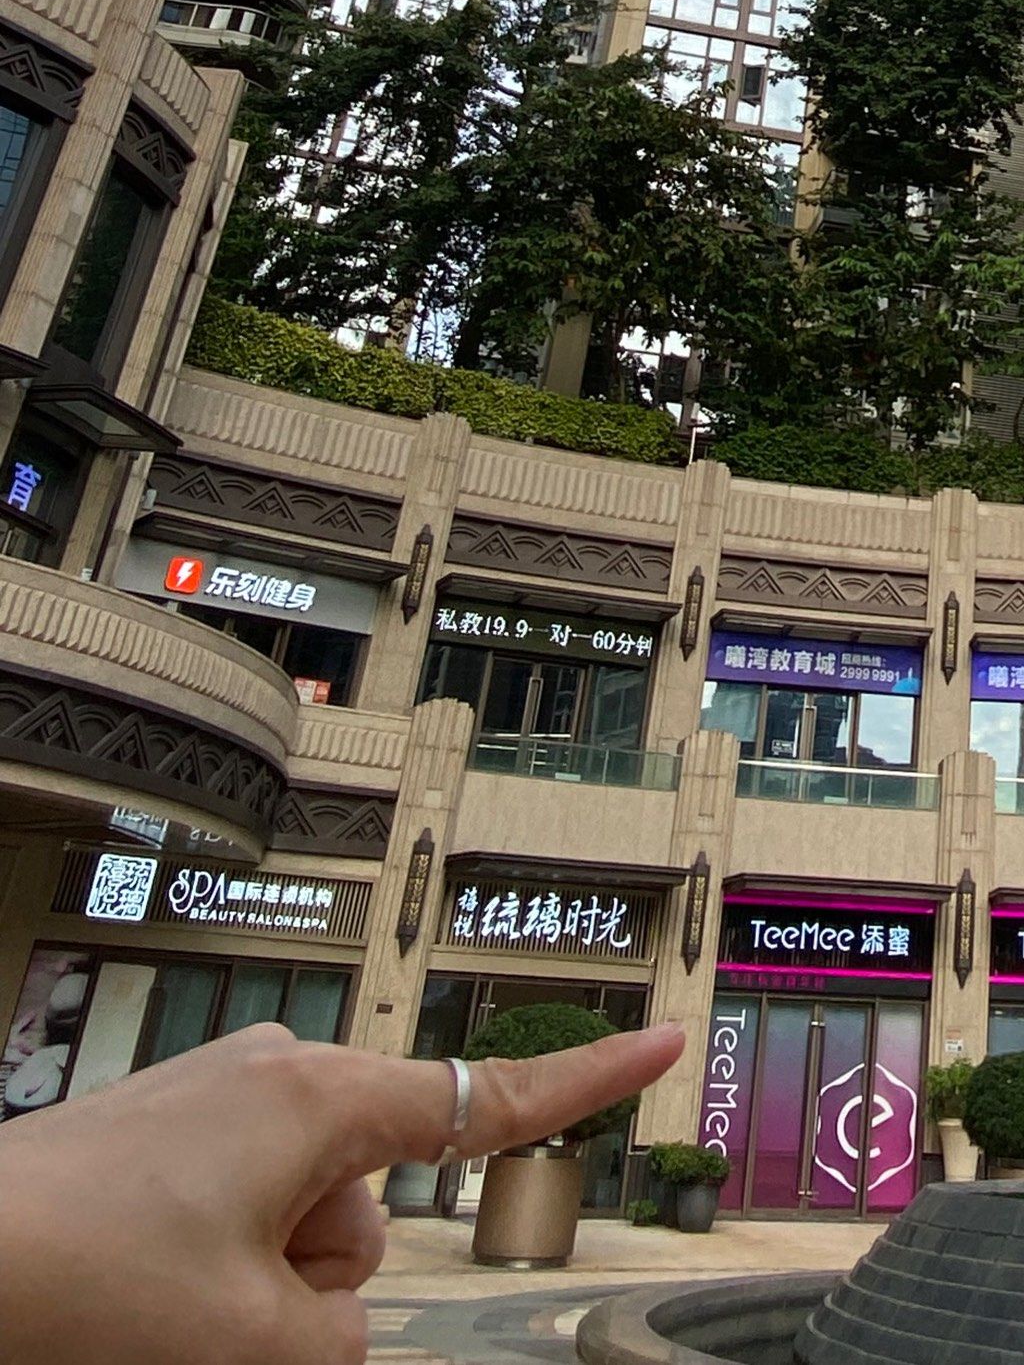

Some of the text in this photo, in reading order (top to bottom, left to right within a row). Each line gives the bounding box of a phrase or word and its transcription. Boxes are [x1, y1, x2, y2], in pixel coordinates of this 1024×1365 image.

[206, 566, 317, 612] 乐刻健身
[189, 907, 246, 923] BEAUTY
[481, 891, 631, 948] 琉璃时光
[751, 919, 910, 956] TeeMee 添蜜
